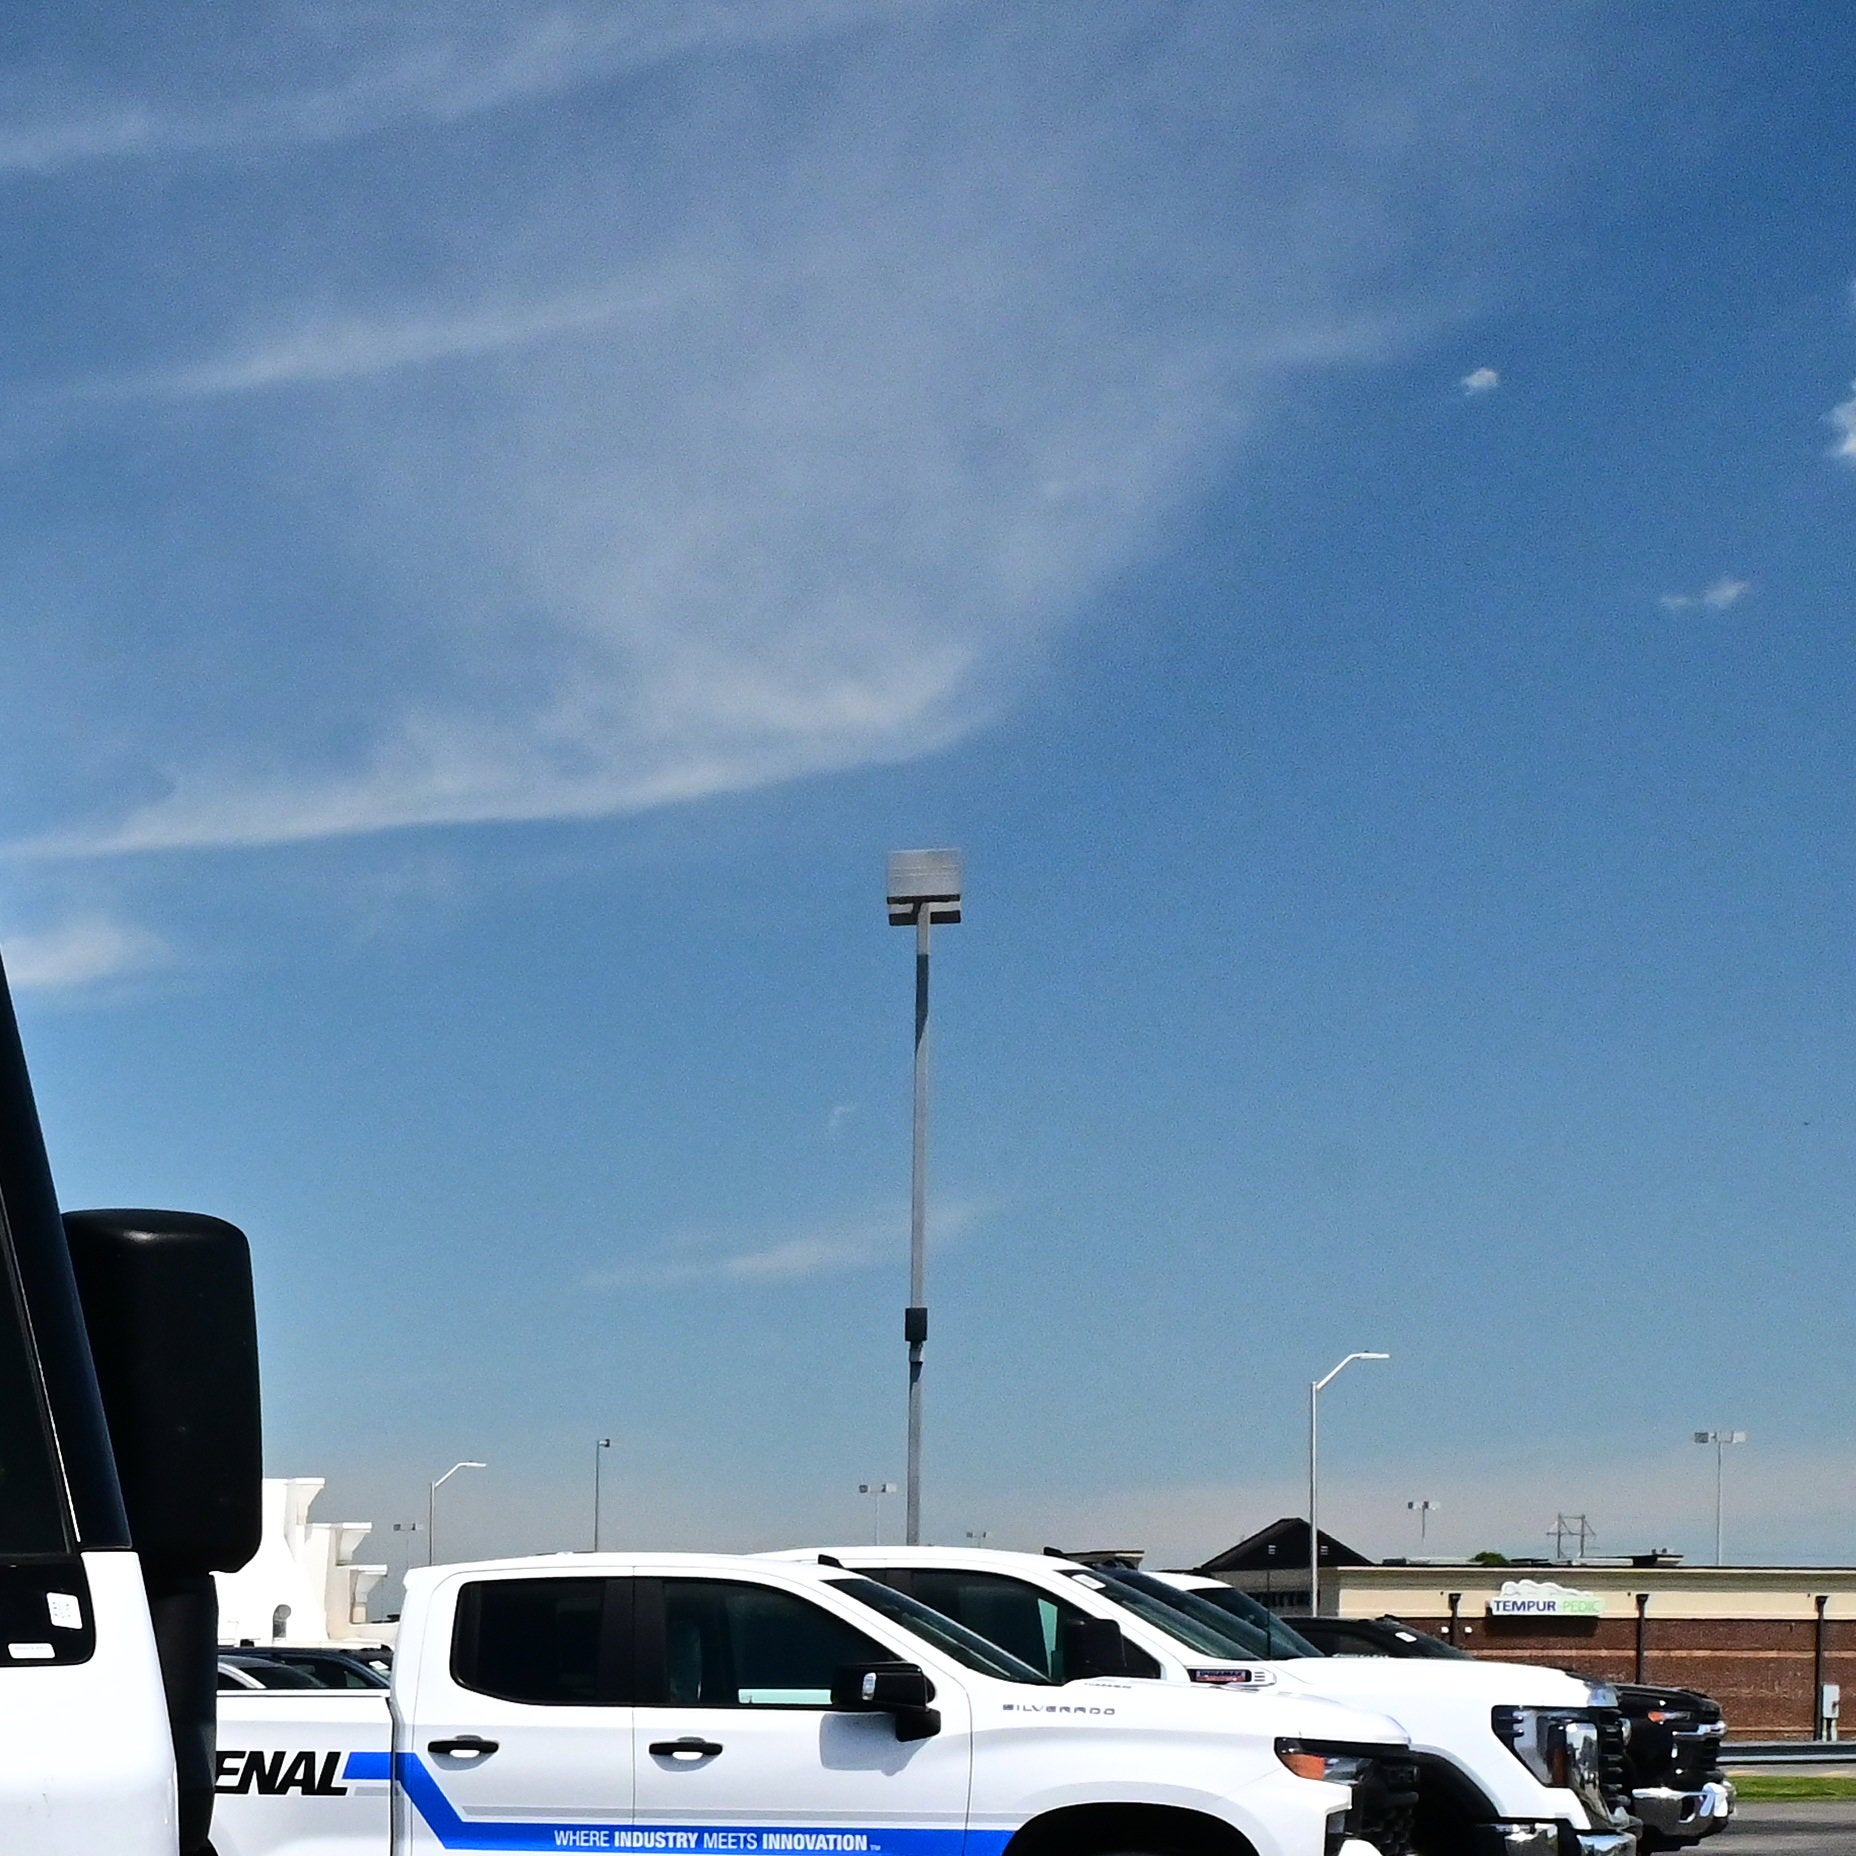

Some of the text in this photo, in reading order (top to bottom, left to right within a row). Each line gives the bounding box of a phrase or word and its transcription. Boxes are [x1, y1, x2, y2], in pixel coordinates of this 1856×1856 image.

[1494, 1600, 1556, 1612] TEMPUR
[1002, 1703, 1116, 1716] SILVERADO
[554, 1829, 610, 1847] WHERE
[614, 1831, 699, 1849] INDUSTRY
[703, 1832, 758, 1850] MEETS
[762, 1833, 868, 1851] INNOVATION
